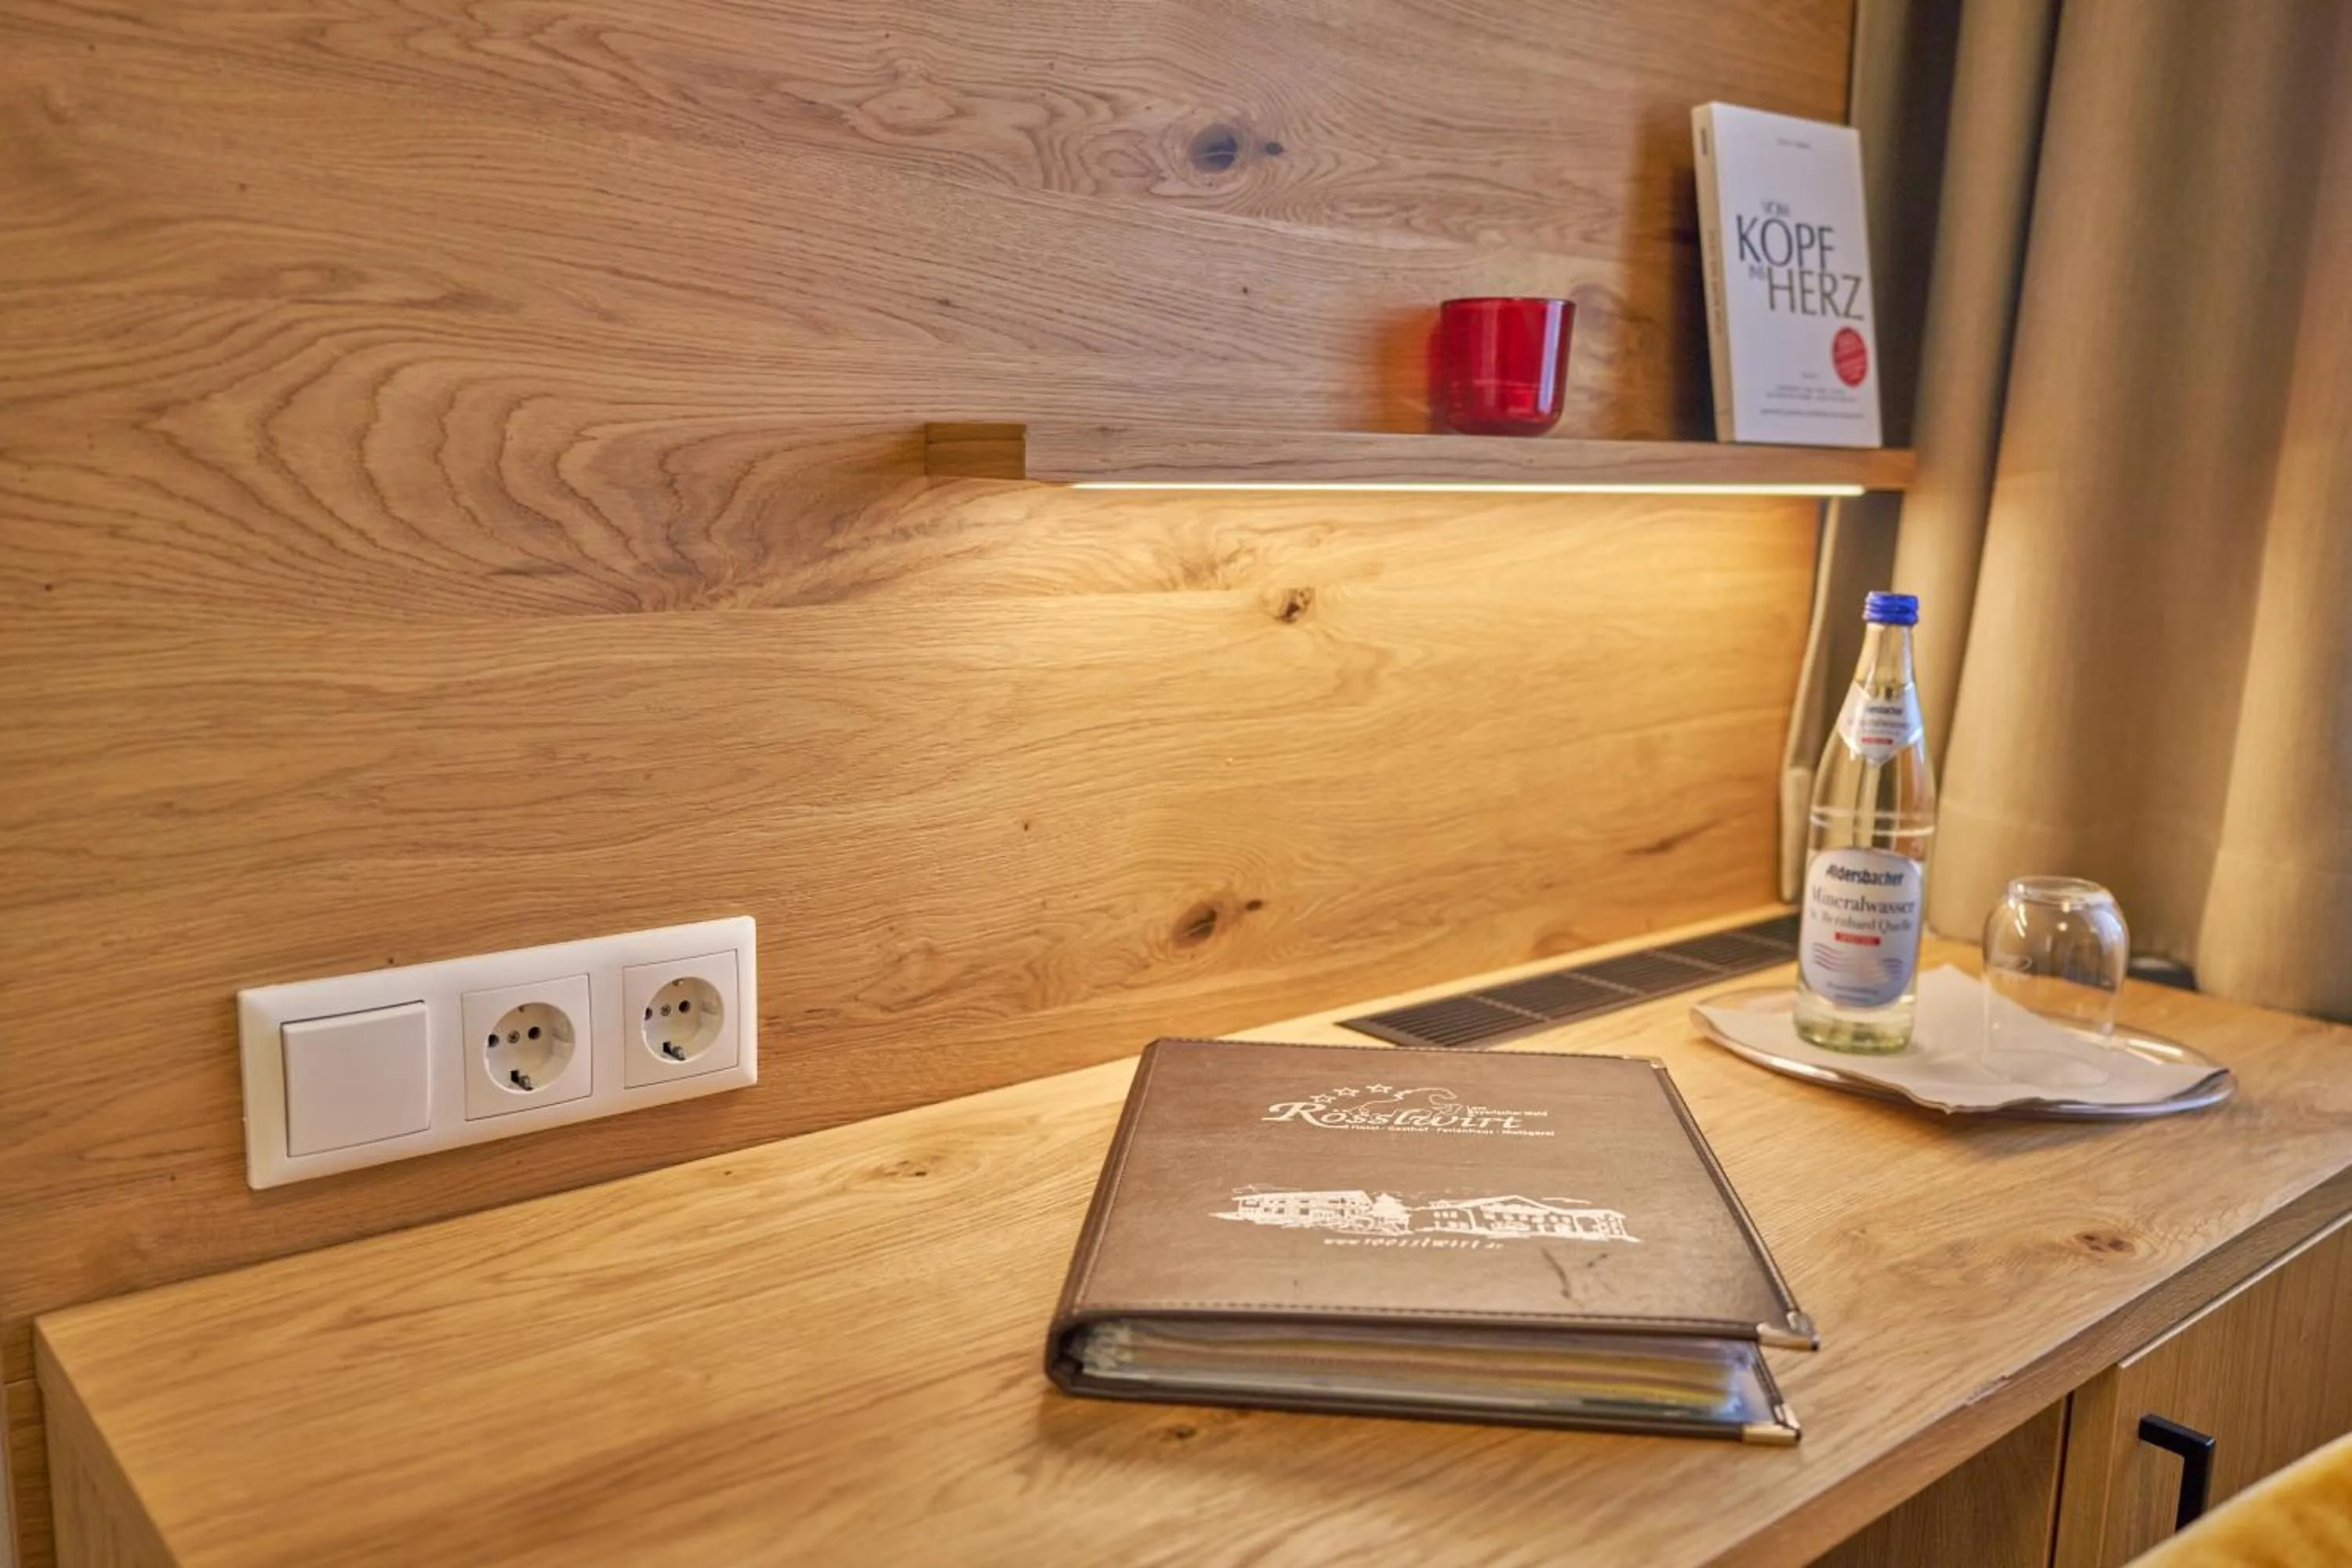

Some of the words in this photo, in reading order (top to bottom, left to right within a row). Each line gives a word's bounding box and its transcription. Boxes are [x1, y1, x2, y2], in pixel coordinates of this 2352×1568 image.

[1736, 213, 1835, 270] KOPF
[1767, 267, 1865, 321] HERZ
[1812, 886, 1915, 914] Mineralwasser
